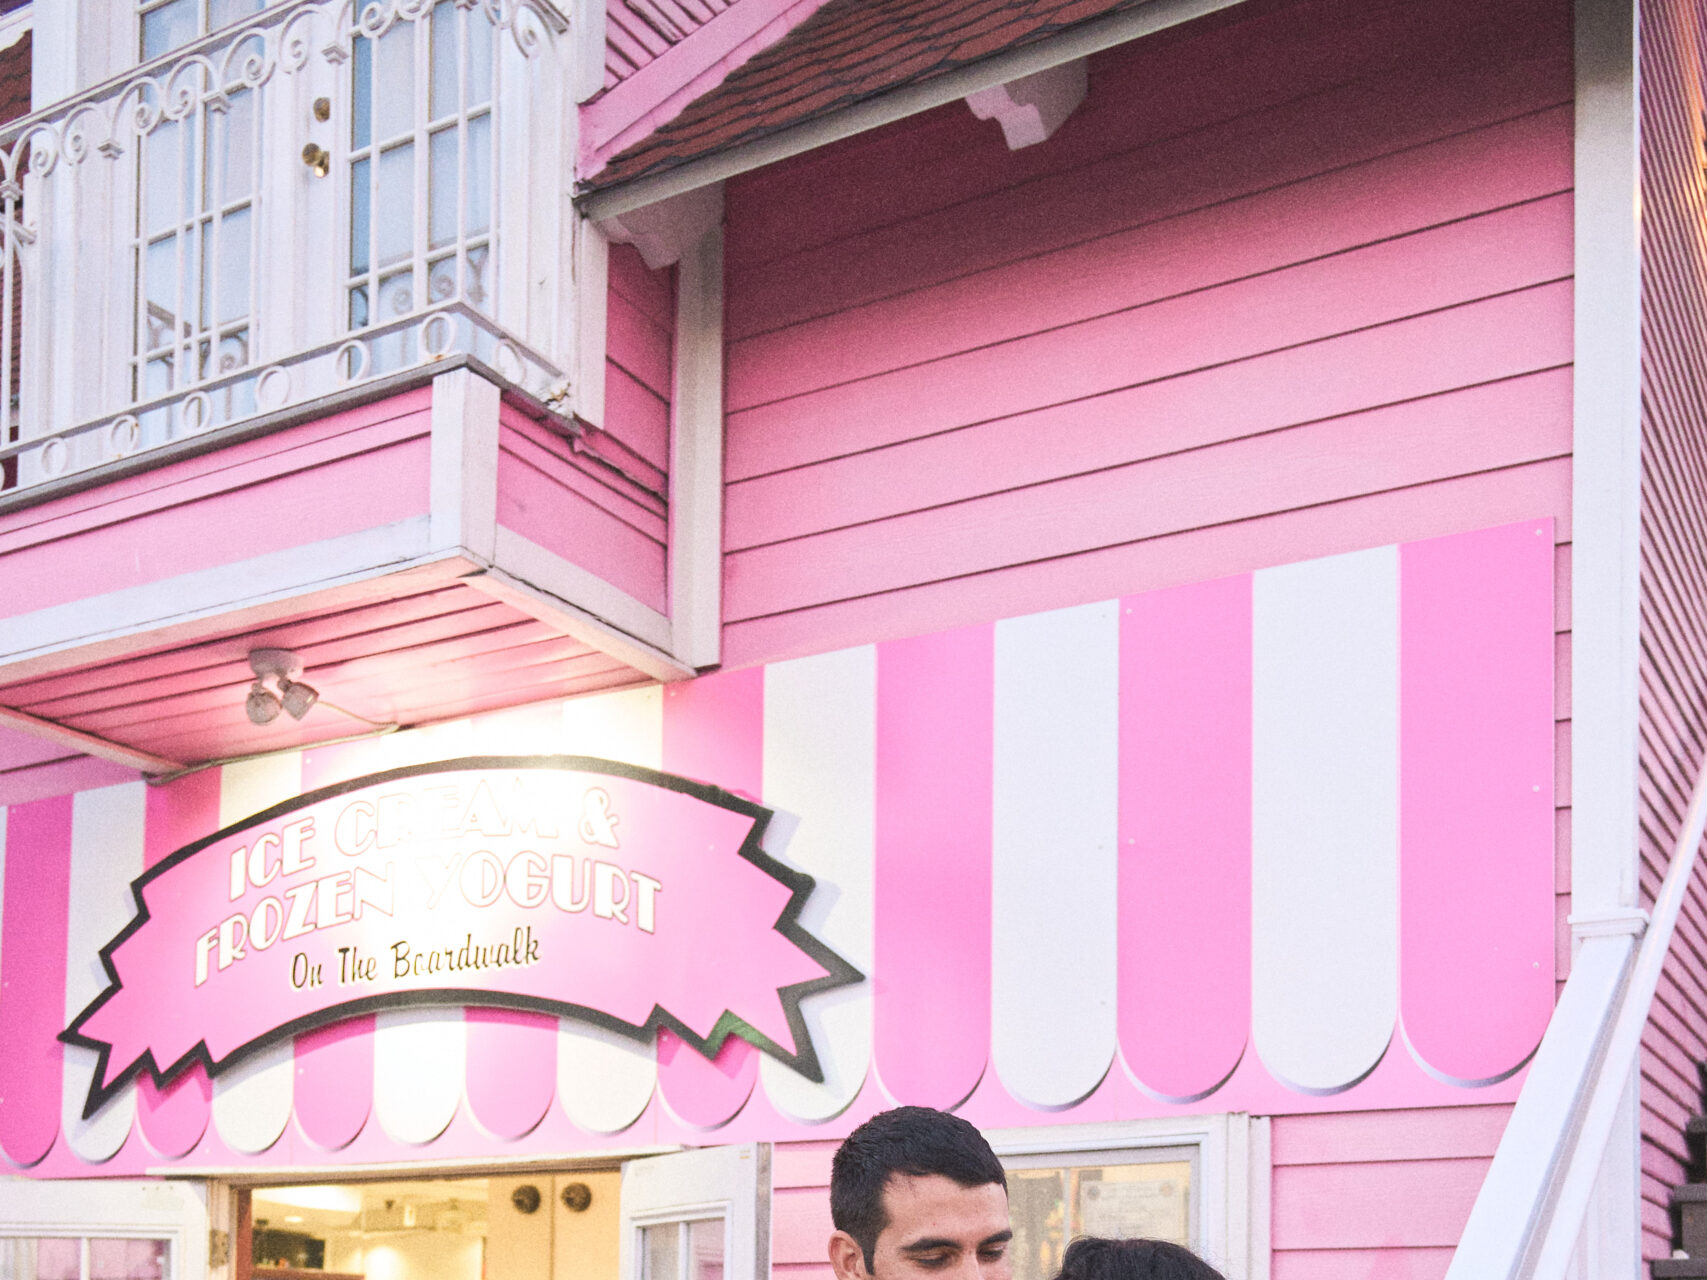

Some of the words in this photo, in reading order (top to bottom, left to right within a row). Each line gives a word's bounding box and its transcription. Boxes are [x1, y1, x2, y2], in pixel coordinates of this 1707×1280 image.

[229, 816, 316, 902] ICE
[578, 786, 621, 849] &
[195, 858, 394, 988] FROZEN
[415, 849, 663, 934] YOGURT
[291, 952, 323, 990] On
[337, 946, 377, 983] The
[391, 925, 542, 980] Boardwalk
